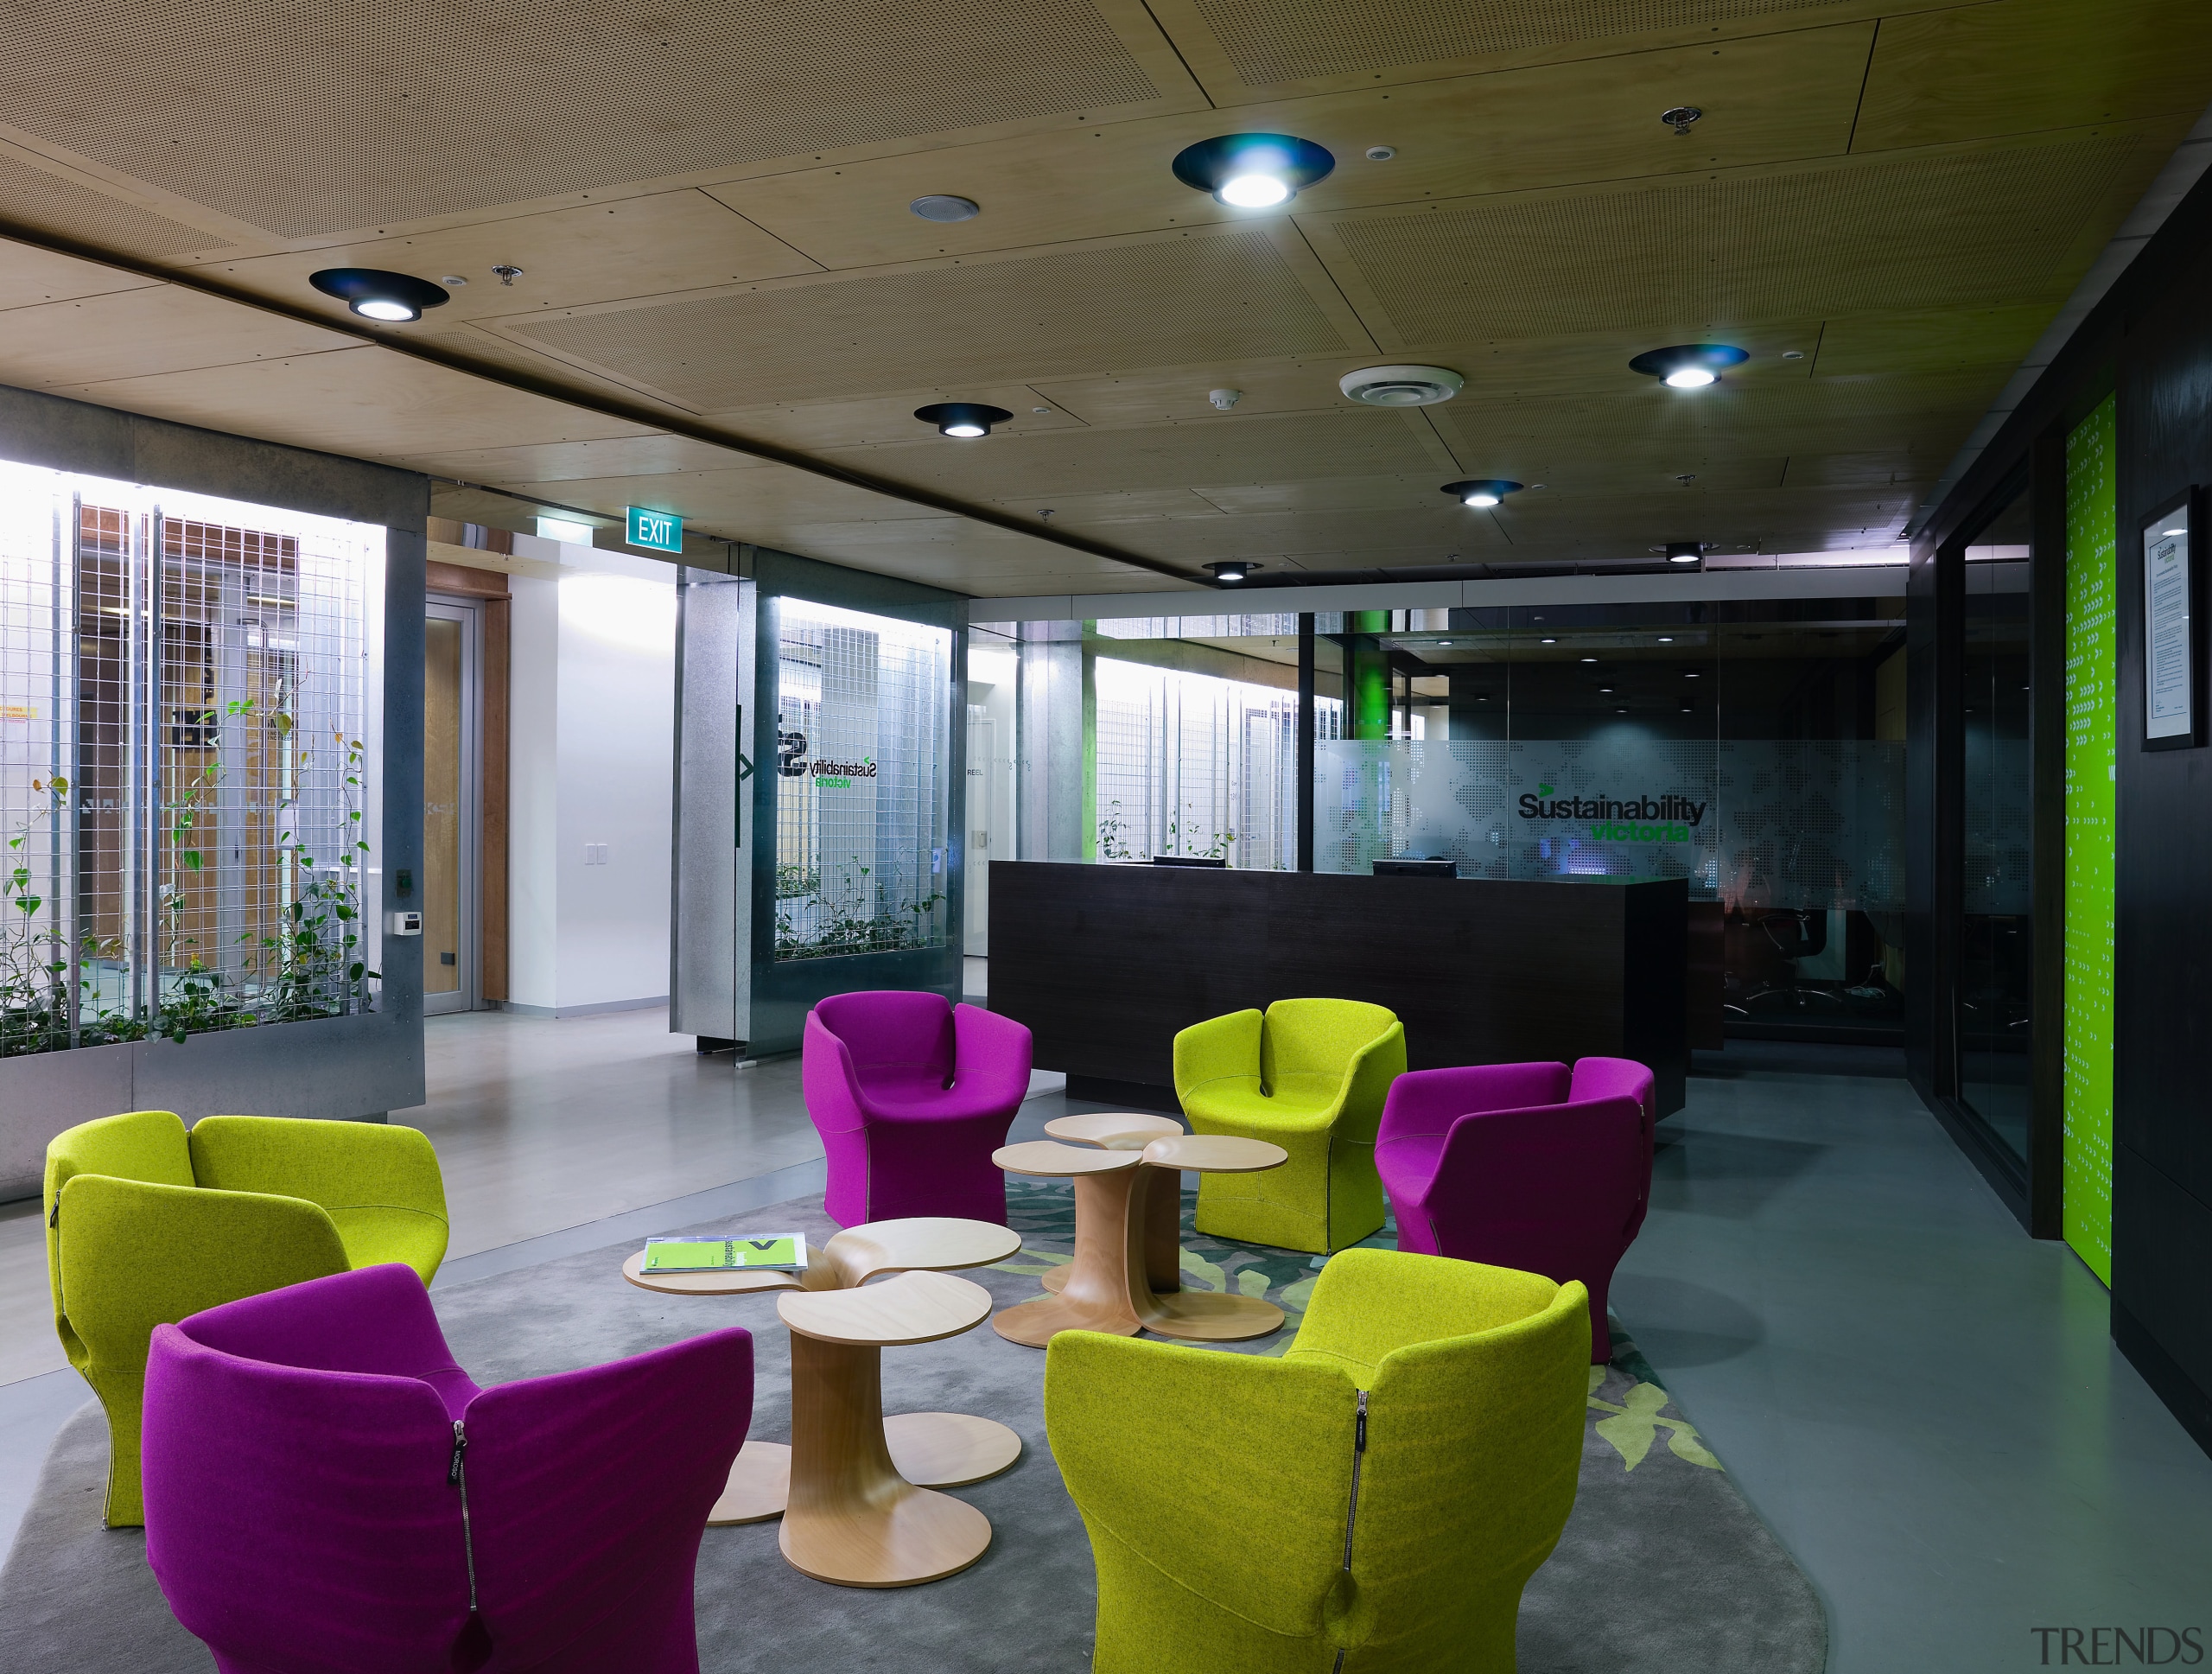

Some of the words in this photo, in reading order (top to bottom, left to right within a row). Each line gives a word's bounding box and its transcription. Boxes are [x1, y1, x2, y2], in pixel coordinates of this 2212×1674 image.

[639, 516, 672, 545] EXIT
[1518, 793, 1707, 826] Sustainability
[1591, 820, 1689, 843] victoria
